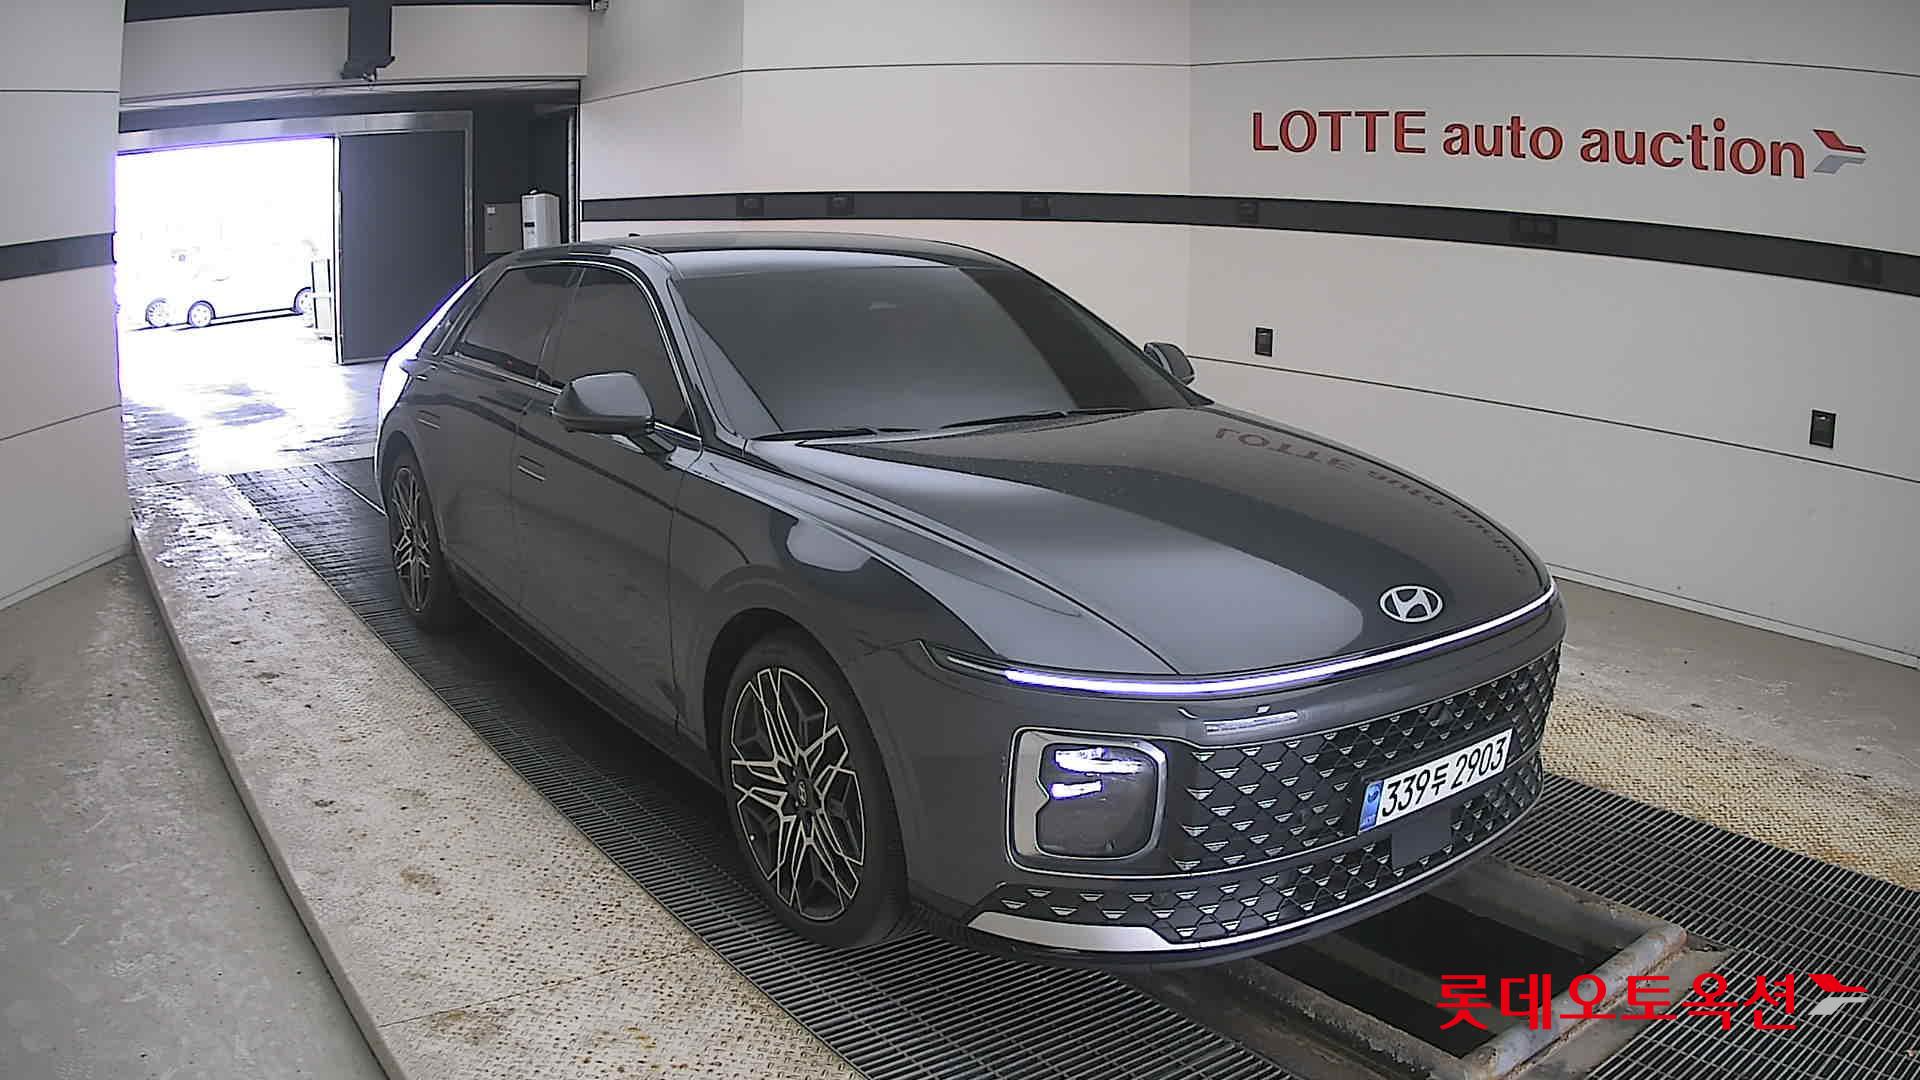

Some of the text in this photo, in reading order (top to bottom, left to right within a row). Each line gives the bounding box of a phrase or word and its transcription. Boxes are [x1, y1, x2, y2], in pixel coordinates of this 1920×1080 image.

[1252, 110, 1806, 179] LOTTE auto auction
[1451, 737, 1507, 790] 2903
